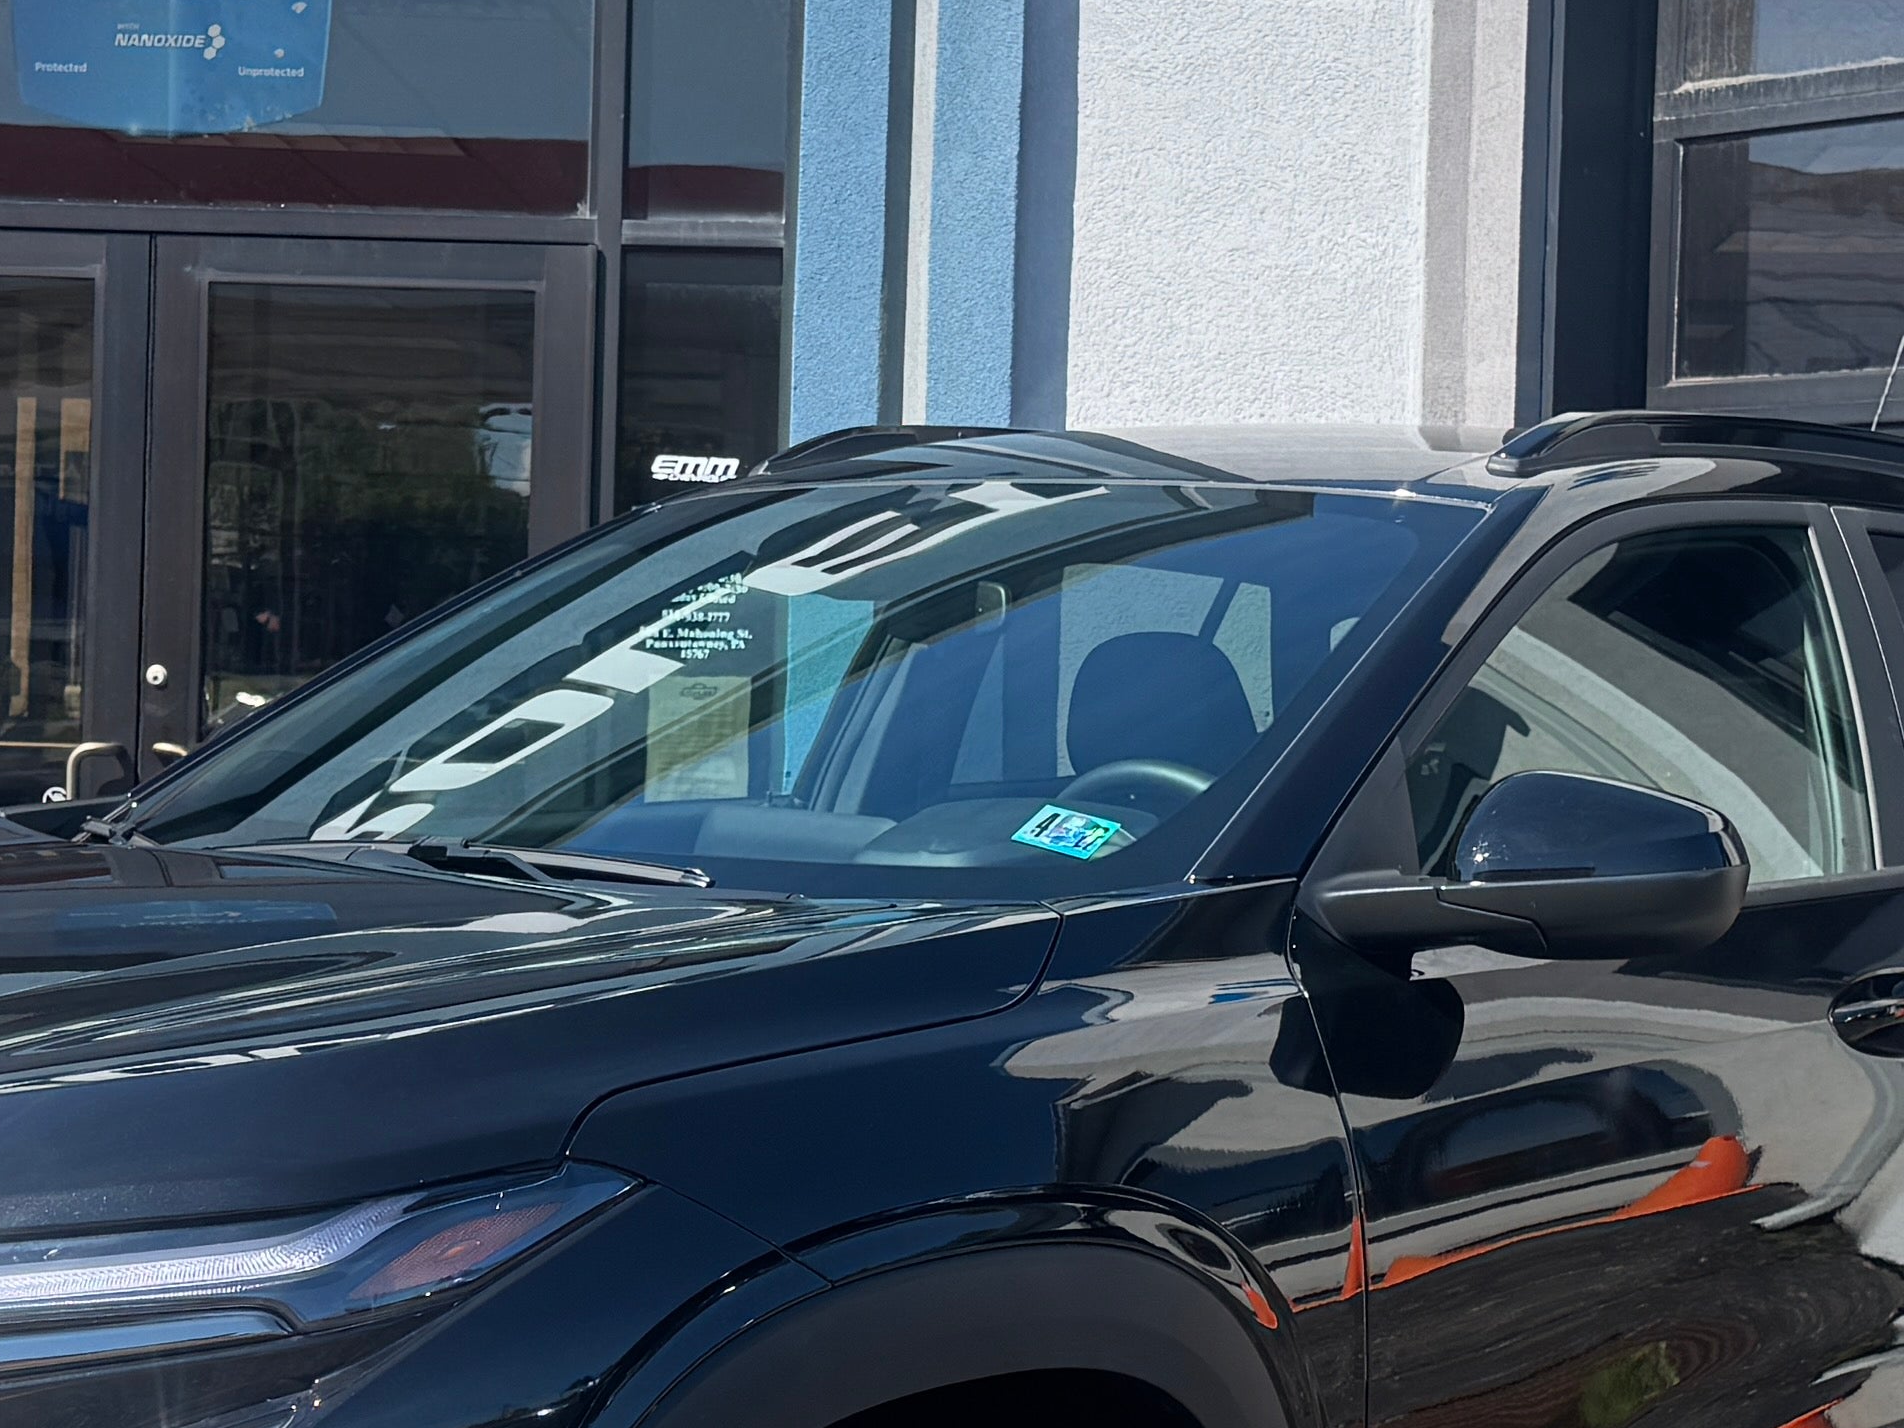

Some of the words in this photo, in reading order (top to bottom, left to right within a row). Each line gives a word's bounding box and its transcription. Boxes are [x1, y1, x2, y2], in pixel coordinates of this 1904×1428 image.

[114, 33, 206, 49] NANOXIDE
[34, 62, 88, 73] Protected
[238, 66, 305, 78] Unprotected
[1030, 812, 1061, 838] 4
